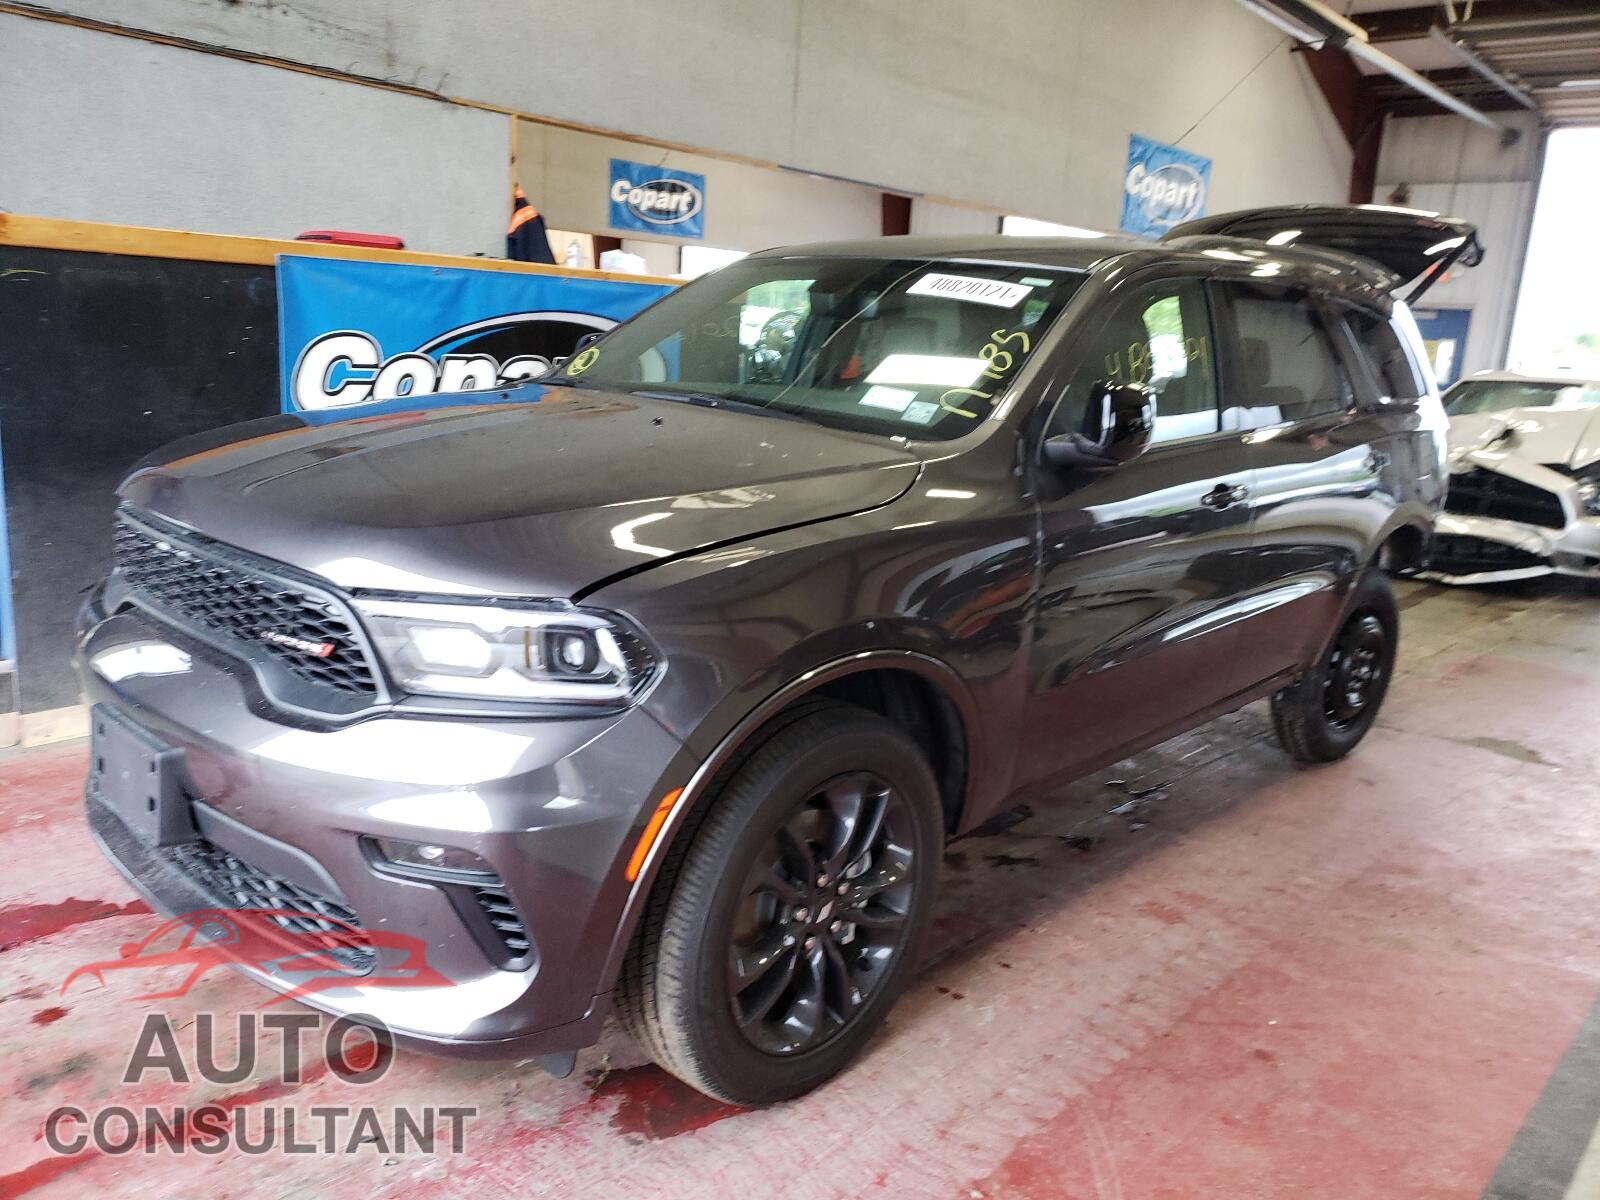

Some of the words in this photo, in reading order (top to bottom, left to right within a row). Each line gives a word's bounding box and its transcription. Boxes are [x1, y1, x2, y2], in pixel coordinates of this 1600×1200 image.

[611, 179, 691, 211] Copart
[1127, 164, 1198, 209] Copart
[291, 330, 566, 411] Copa
